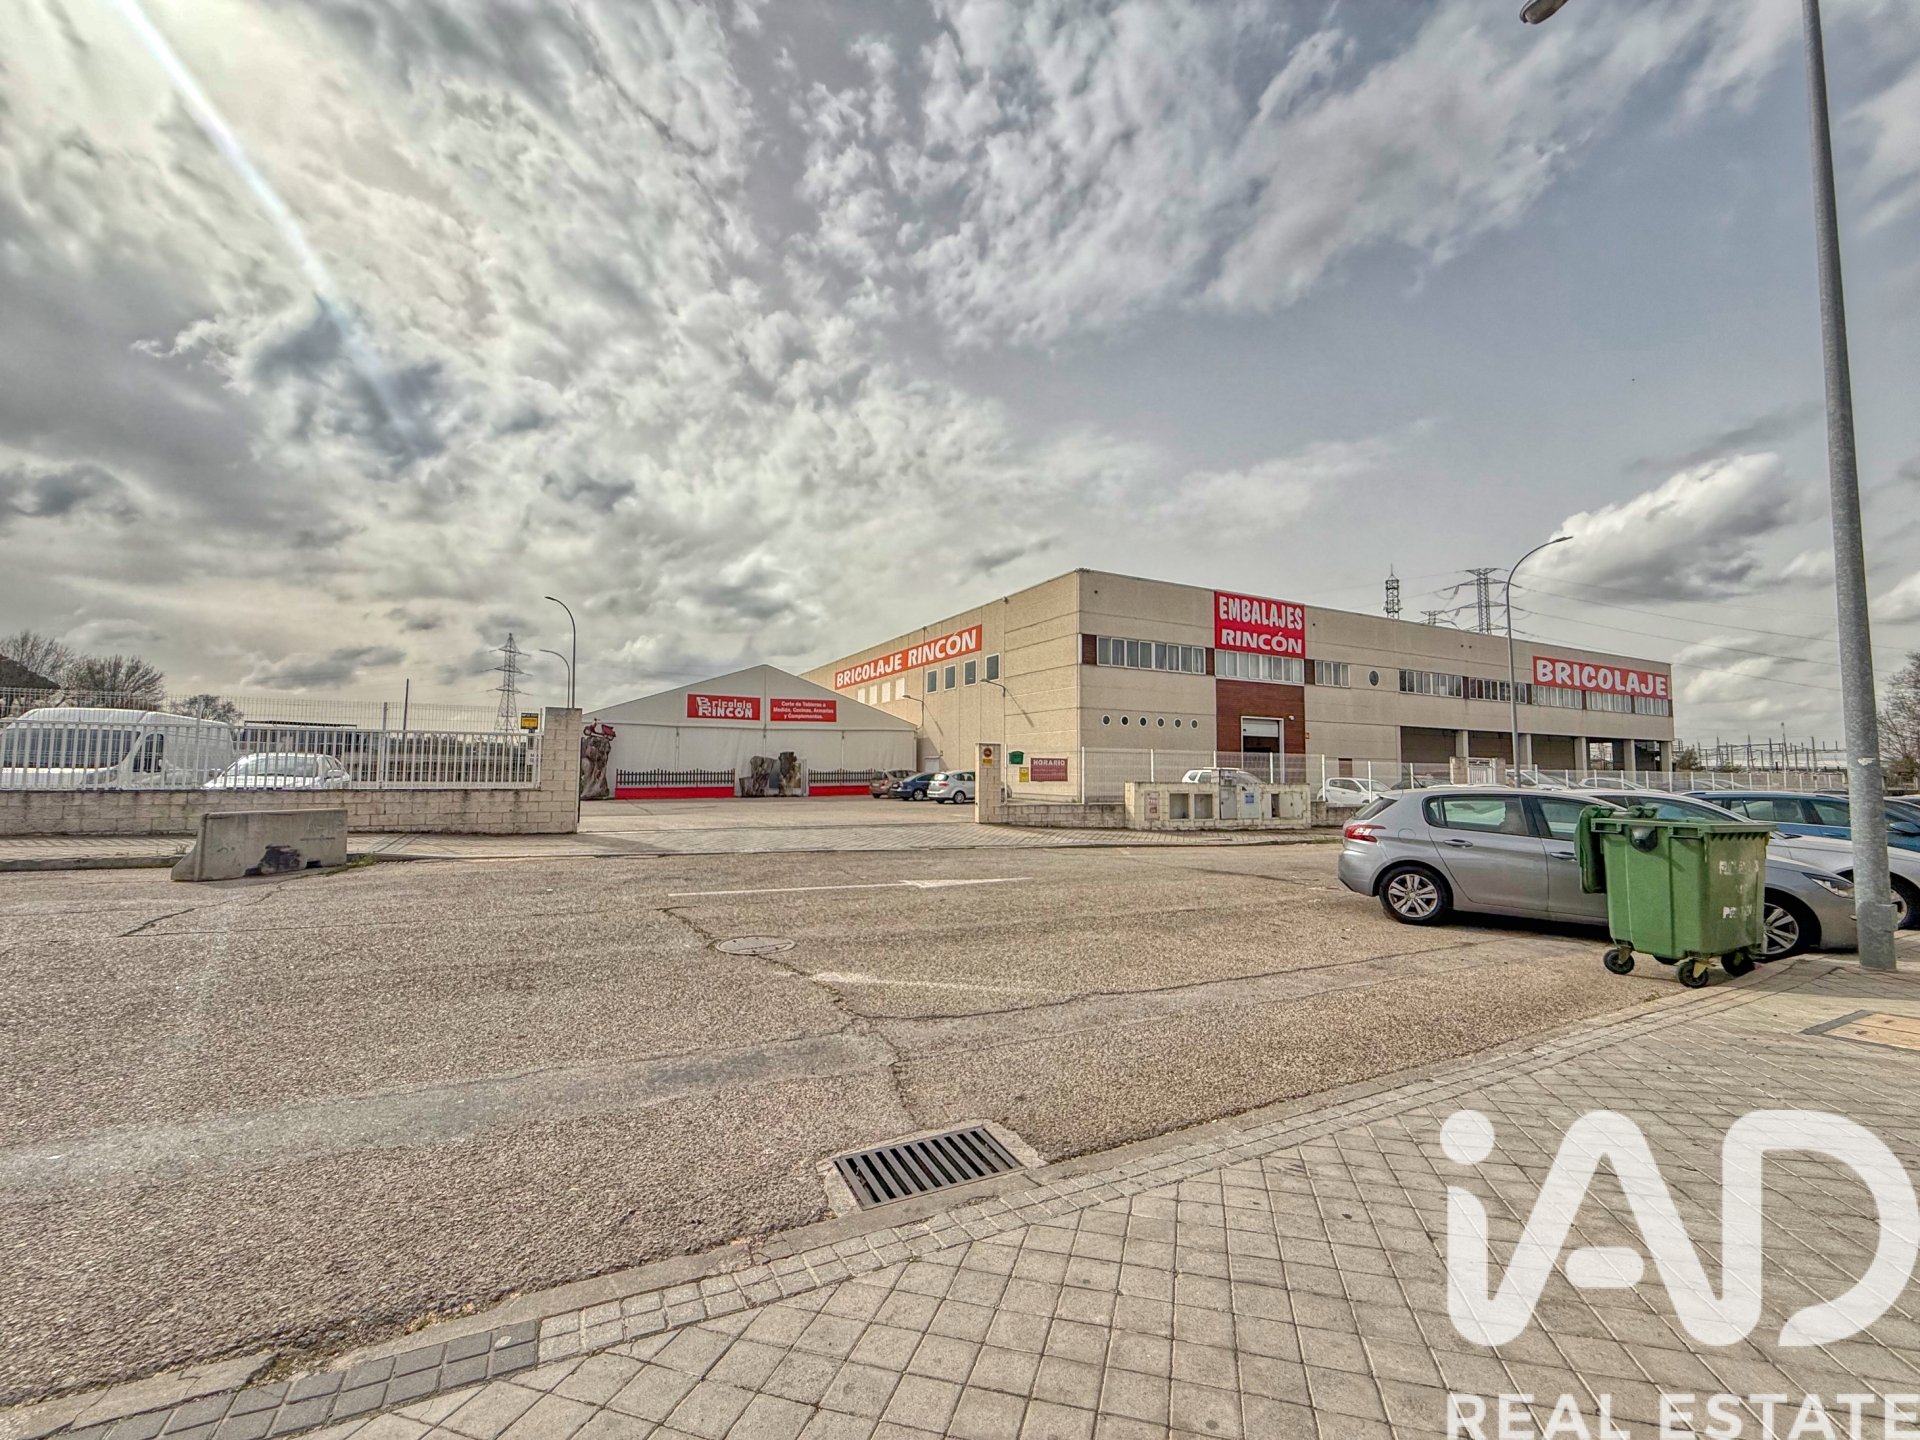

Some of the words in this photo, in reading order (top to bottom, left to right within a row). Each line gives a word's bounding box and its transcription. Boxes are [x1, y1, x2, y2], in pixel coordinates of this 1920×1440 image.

[1219, 596, 1303, 630] EMBALAJES
[836, 653, 902, 687] BRICOLAJE
[907, 628, 977, 667] RINCÓN
[1221, 628, 1302, 654] RINCÓN
[1536, 660, 1667, 695] BRICOLAJE
